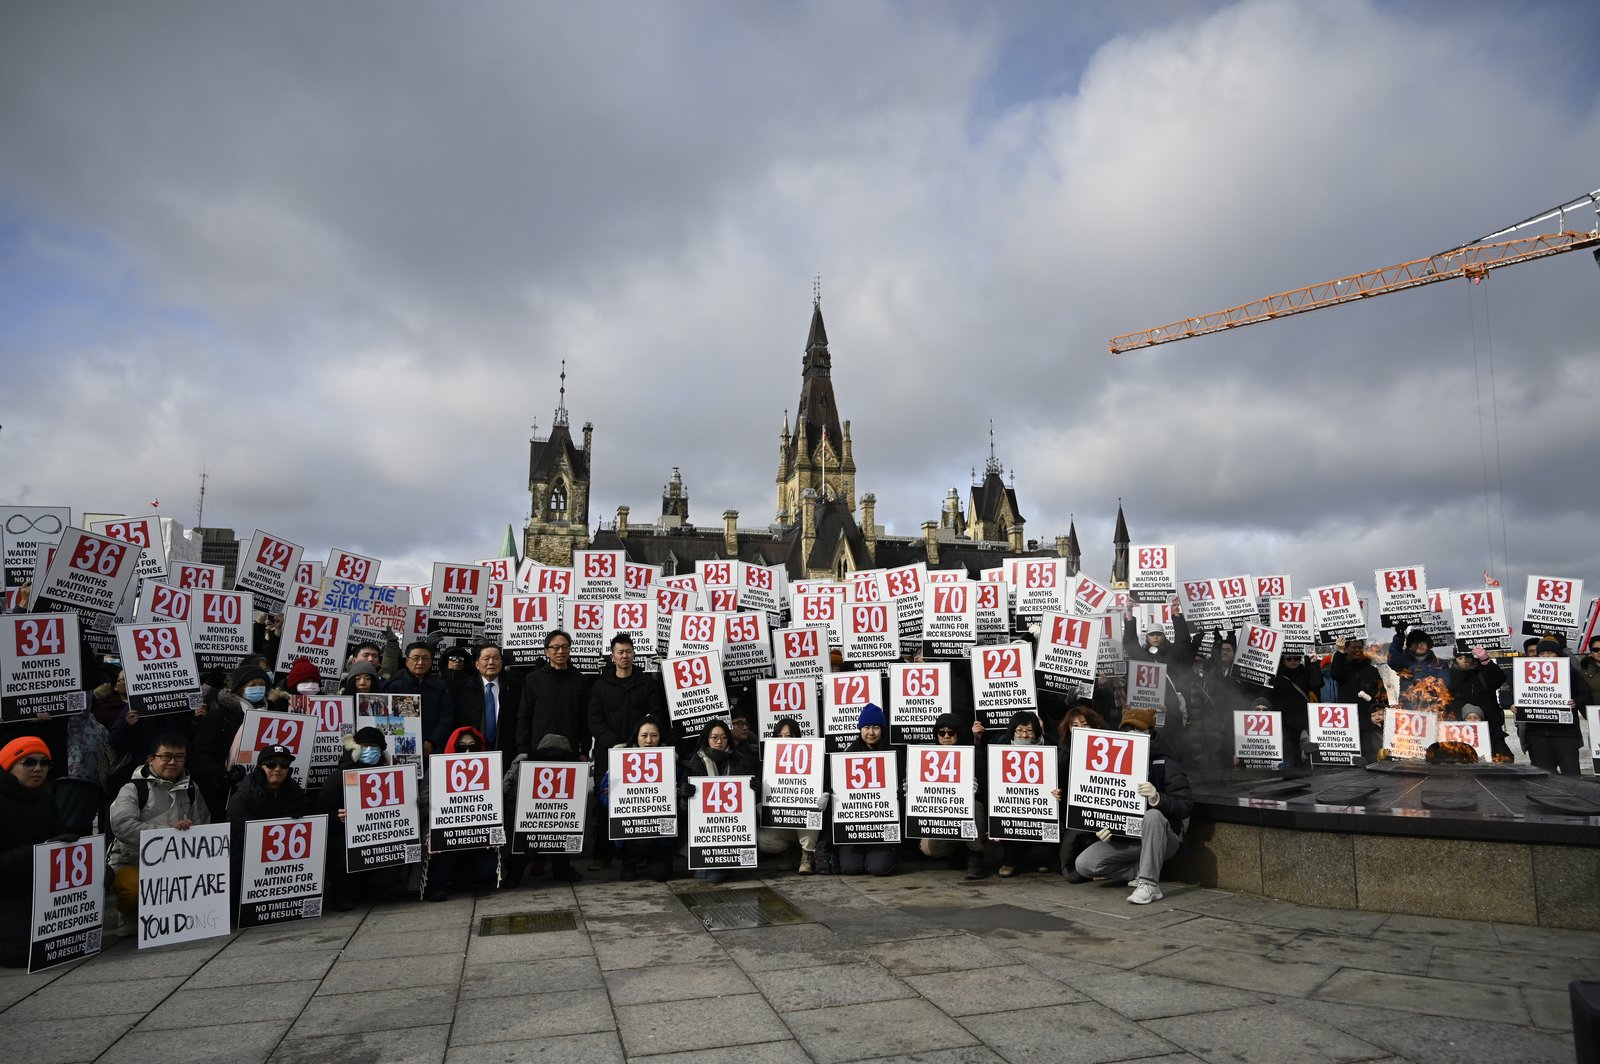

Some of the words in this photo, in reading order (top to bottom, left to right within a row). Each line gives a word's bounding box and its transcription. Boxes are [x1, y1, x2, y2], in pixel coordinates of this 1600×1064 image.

[76, 538, 120, 575] 36
[260, 541, 289, 568] 42
[588, 554, 613, 577] 53
[1141, 548, 1164, 568] 38
[184, 568, 213, 588] 36
[340, 556, 367, 583] 39
[626, 567, 647, 590] 31
[706, 564, 728, 584] 25
[749, 567, 769, 589] 33
[1029, 563, 1053, 588] 35
[1389, 570, 1414, 591] 31
[331, 580, 364, 596] STOP
[369, 586, 396, 602] THE
[449, 569, 473, 594] 11
[542, 570, 566, 593] 15
[856, 581, 878, 602] 46
[890, 571, 916, 595] 33
[1187, 582, 1212, 600] 32
[1222, 579, 1243, 597] 19
[1261, 578, 1282, 596] 28
[1540, 580, 1568, 601] 33
[155, 589, 188, 618] 20
[658, 591, 684, 614] 34
[714, 590, 736, 611] 27
[938, 587, 964, 613] 70
[976, 586, 996, 608] 23
[1079, 581, 1103, 608] 27
[1323, 588, 1346, 608] 37
[1463, 593, 1491, 615] 34
[208, 596, 237, 623] 40
[518, 598, 543, 621] 71
[578, 605, 602, 629] 53
[618, 604, 643, 628] 63
[806, 597, 831, 620] 55
[856, 607, 883, 632] 90
[1282, 602, 1303, 622] 37
[21, 620, 60, 655] 34
[300, 616, 333, 647] 54
[684, 616, 711, 641] 68
[729, 618, 756, 643] 55
[1056, 619, 1082, 647] 11
[1250, 628, 1275, 650] 30
[138, 628, 177, 659] 38
[788, 632, 815, 658] 34
[12, 670, 50, 681] WAITING
[53, 669, 70, 677] FOR
[22, 659, 60, 669] MONTHS
[678, 659, 706, 688] 39
[986, 649, 1018, 678] 22
[1528, 662, 1555, 683] 39
[7, 683, 27, 692] IRCC
[29, 679, 76, 690] RESPONSE
[906, 669, 935, 696] 65
[1139, 666, 1157, 687] 31
[29, 694, 68, 705] TIMELINES
[772, 683, 802, 711] 40
[838, 677, 865, 704] 72
[33, 703, 65, 713] RESULTS
[310, 701, 339, 732] 40
[1321, 707, 1345, 727] 23
[261, 720, 298, 753] 42
[1247, 714, 1270, 736] 22
[1398, 714, 1424, 736] 20
[779, 744, 808, 774] 40
[1092, 737, 1128, 772] 37
[451, 758, 484, 792] 62
[627, 754, 658, 782] 35
[851, 758, 881, 788] 51
[924, 752, 956, 782] 34
[1006, 752, 1039, 783] 36
[366, 774, 400, 806] 31
[537, 768, 568, 799] 81
[1080, 784, 1116, 796] WAITING
[1118, 789, 1135, 798] FOR
[1090, 775, 1126, 787] MONTHS
[450, 795, 484, 804] MONTHS
[707, 782, 738, 812] 43
[1074, 794, 1093, 803] IRCC
[1094, 797, 1140, 810] RESPONSE
[441, 805, 475, 814] WAITING
[455, 813, 497, 823] RESPONSE
[1094, 812, 1126, 822] TIMELINE
[455, 828, 490, 837] TIMELINES
[1096, 822, 1126, 831] RESULTS
[141, 835, 230, 866] CANADA
[266, 824, 307, 861] 36
[458, 836, 487, 845] RESULTS
[55, 846, 87, 890] 18
[53, 891, 86, 906] MONTHS
[140, 876, 192, 906] WHAT
[192, 873, 226, 899] ARE
[44, 904, 78, 921] WAITING
[80, 901, 94, 912] FOR
[38, 923, 56, 935] IRCC
[58, 912, 98, 930] RESPONSE
[140, 914, 169, 941] YOU
